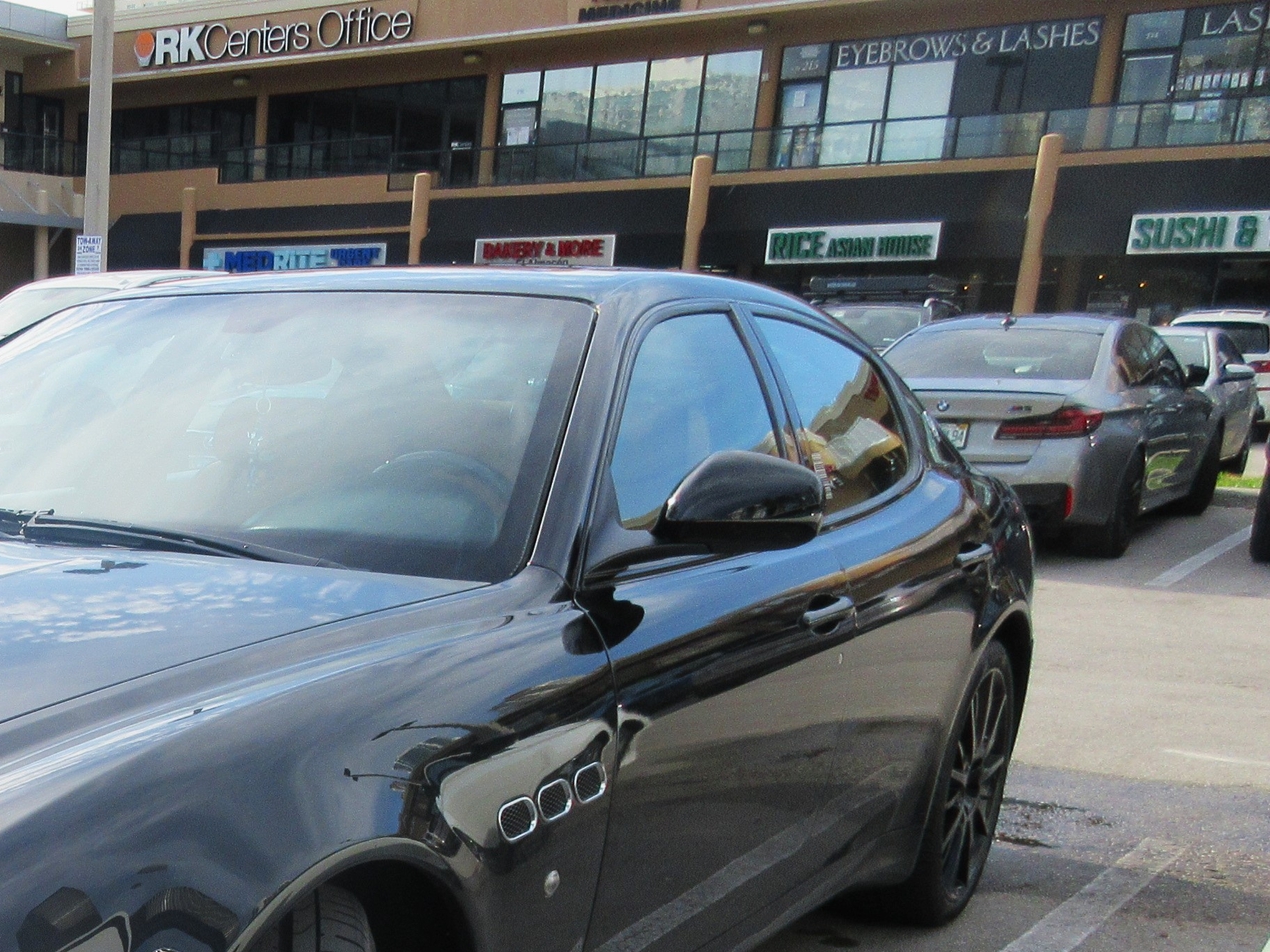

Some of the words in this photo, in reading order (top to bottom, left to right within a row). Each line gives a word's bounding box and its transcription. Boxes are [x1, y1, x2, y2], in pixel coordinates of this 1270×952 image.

[317, 7, 412, 49] Office
[1200, 6, 1270, 35] LAS
[836, 31, 967, 67] EYEBROWS
[971, 31, 995, 55] &
[998, 20, 1101, 54] LASHES
[768, 231, 826, 260] RICE
[827, 237, 875, 258] ASIAN
[876, 235, 933, 257] HOUSE
[1131, 216, 1228, 249] SUSHI
[1234, 216, 1257, 247] &
[331, 247, 381, 259] URGENT
[483, 241, 544, 260] BAKERY
[545, 242, 556, 257] &
[558, 239, 605, 257] MORE
